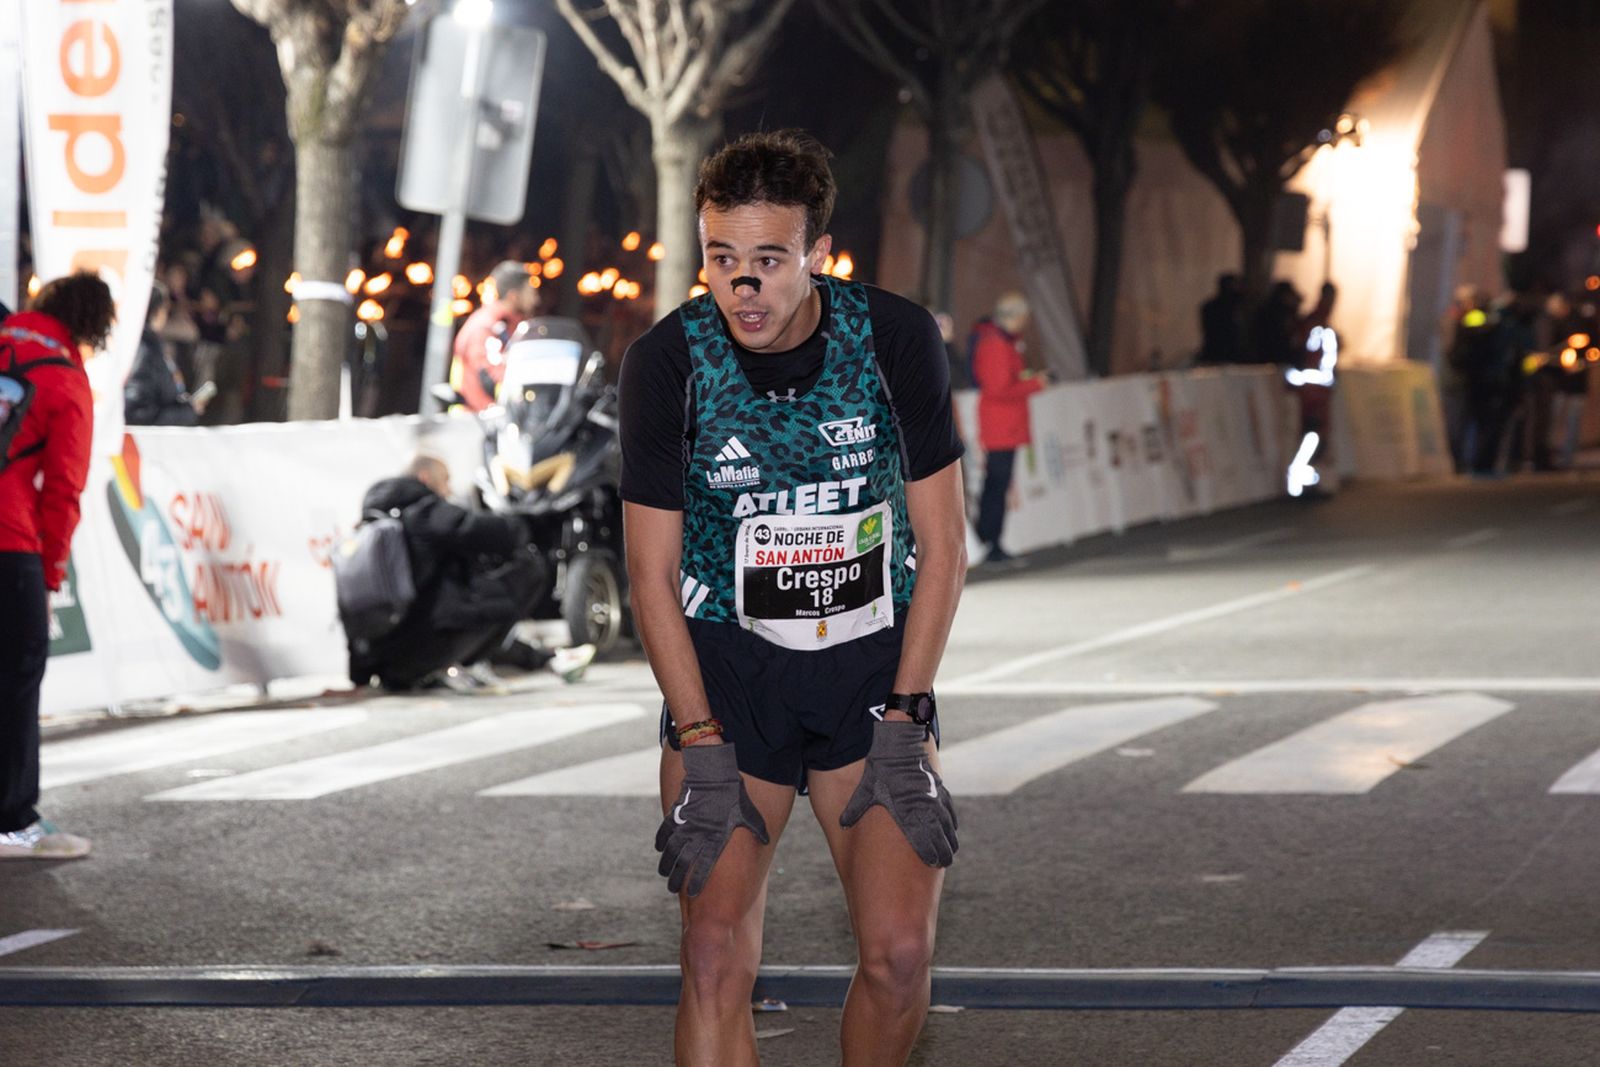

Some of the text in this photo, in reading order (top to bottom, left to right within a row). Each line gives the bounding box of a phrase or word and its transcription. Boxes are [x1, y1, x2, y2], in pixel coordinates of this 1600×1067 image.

[832, 448, 875, 470] GARBE
[732, 476, 867, 518] ATLEET
[756, 528, 770, 540] 43
[774, 530, 845, 546] NOCHE DE
[755, 545, 845, 565] SAN ANTÓN
[776, 562, 861, 591] Crespo
[810, 587, 833, 607] 18
[795, 604, 846, 617] Marcos Crespo
